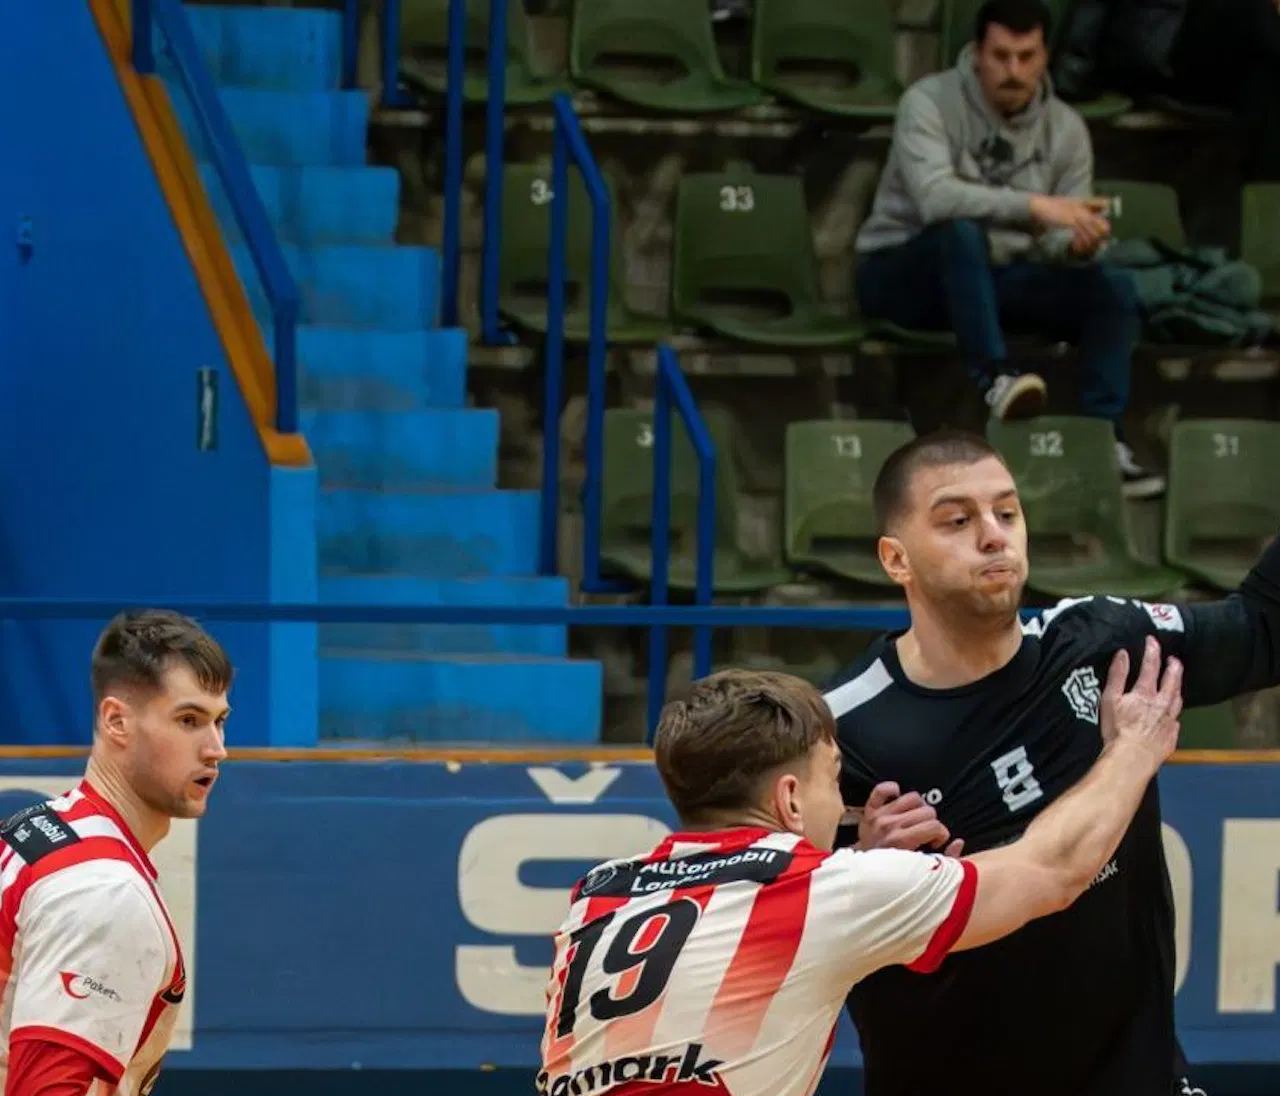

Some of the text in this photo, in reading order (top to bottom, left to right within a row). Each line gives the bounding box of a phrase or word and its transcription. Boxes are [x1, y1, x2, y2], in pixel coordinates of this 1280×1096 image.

[990, 745, 1044, 813] 8
[639, 849, 778, 875] Automobil
[554, 896, 704, 1042] 19
